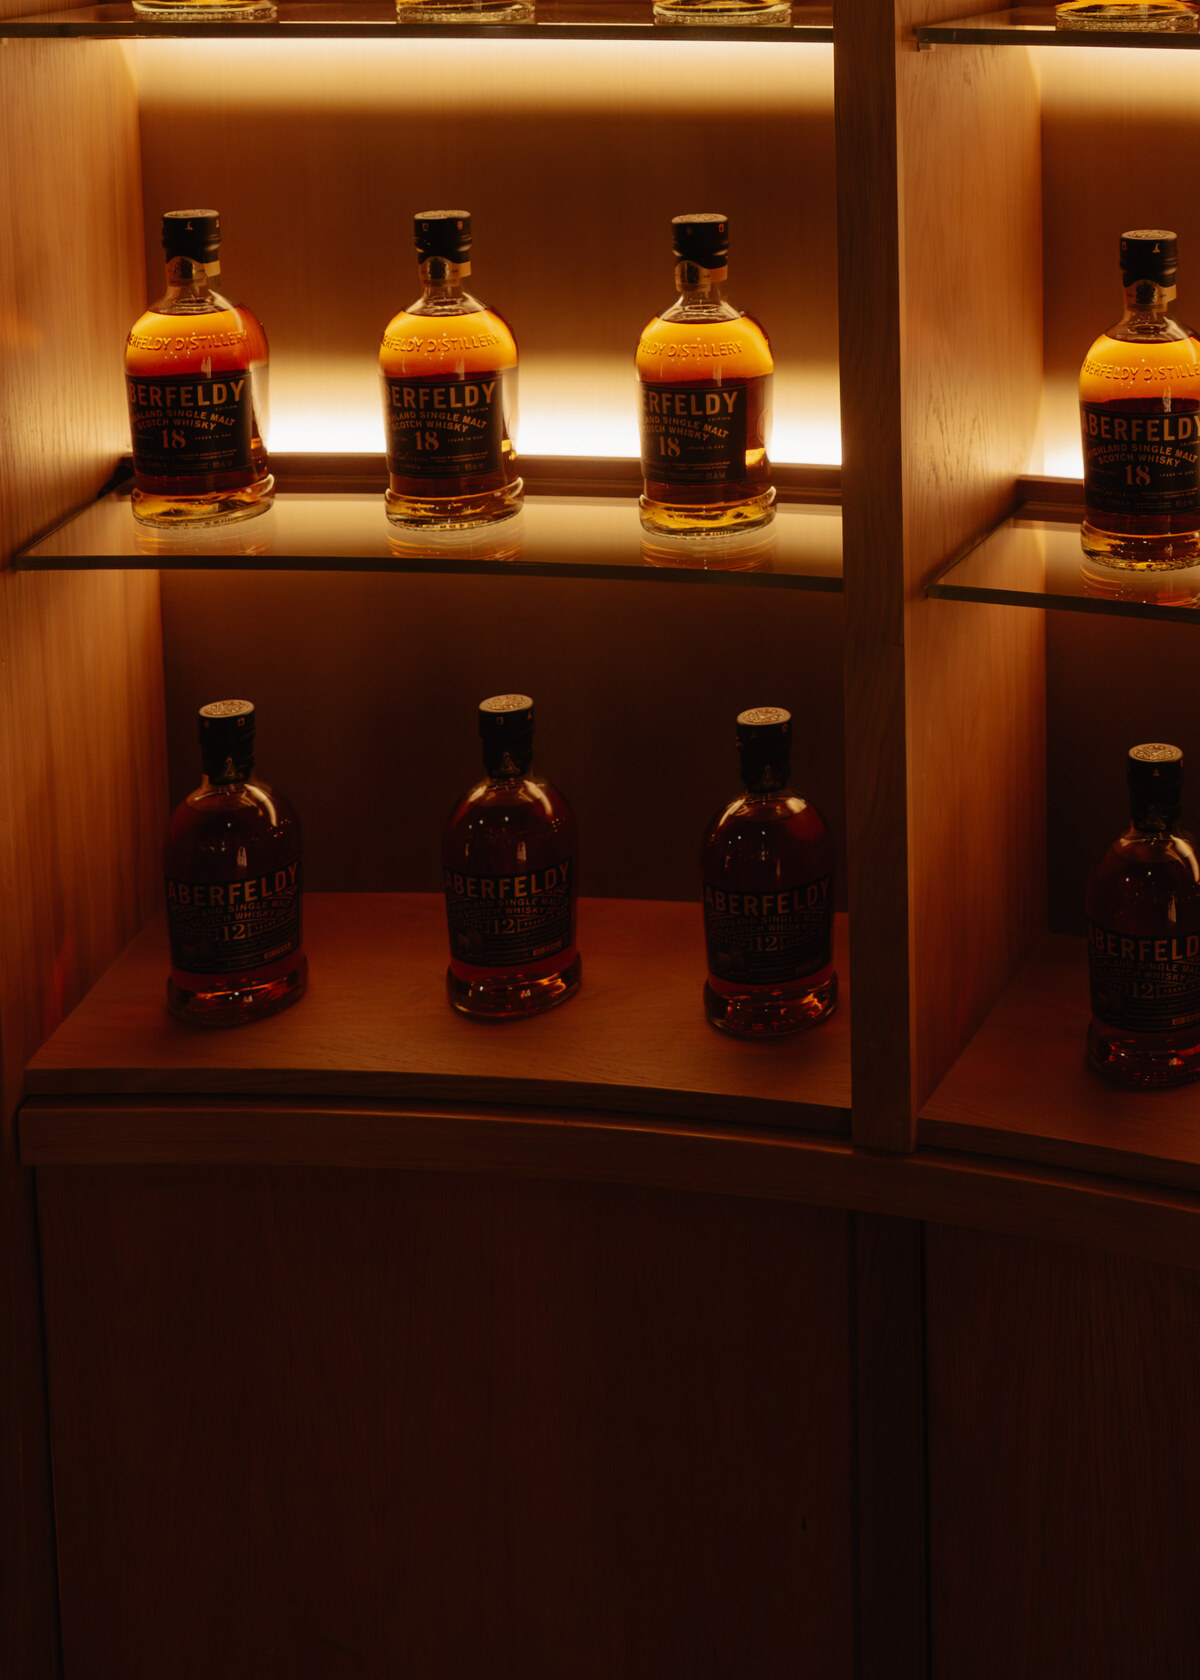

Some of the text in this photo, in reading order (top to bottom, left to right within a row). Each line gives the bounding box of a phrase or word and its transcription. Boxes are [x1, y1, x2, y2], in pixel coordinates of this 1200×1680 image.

[671, 343, 742, 358] DISTILLERY
[130, 379, 244, 407] BERFELDY
[209, 412, 236, 426] MALT
[427, 421, 469, 433] WHISKY
[462, 415, 488, 429] MALT
[162, 428, 186, 448] 18
[704, 423, 729, 439] MALT
[415, 430, 440, 451] 18
[660, 436, 681, 457] 18
[1131, 444, 1199, 463] SINGLE MALT
[1138, 453, 1181, 467] WHISKY
[1125, 463, 1151, 486] 18
[169, 861, 298, 907] ABERFELDY
[446, 861, 569, 900] ABERFELDY
[705, 876, 829, 917] ABERFELDY
[222, 923, 246, 941] 12
[493, 918, 516, 934] 12
[756, 936, 778, 952] 12
[1132, 983, 1154, 999] 12
